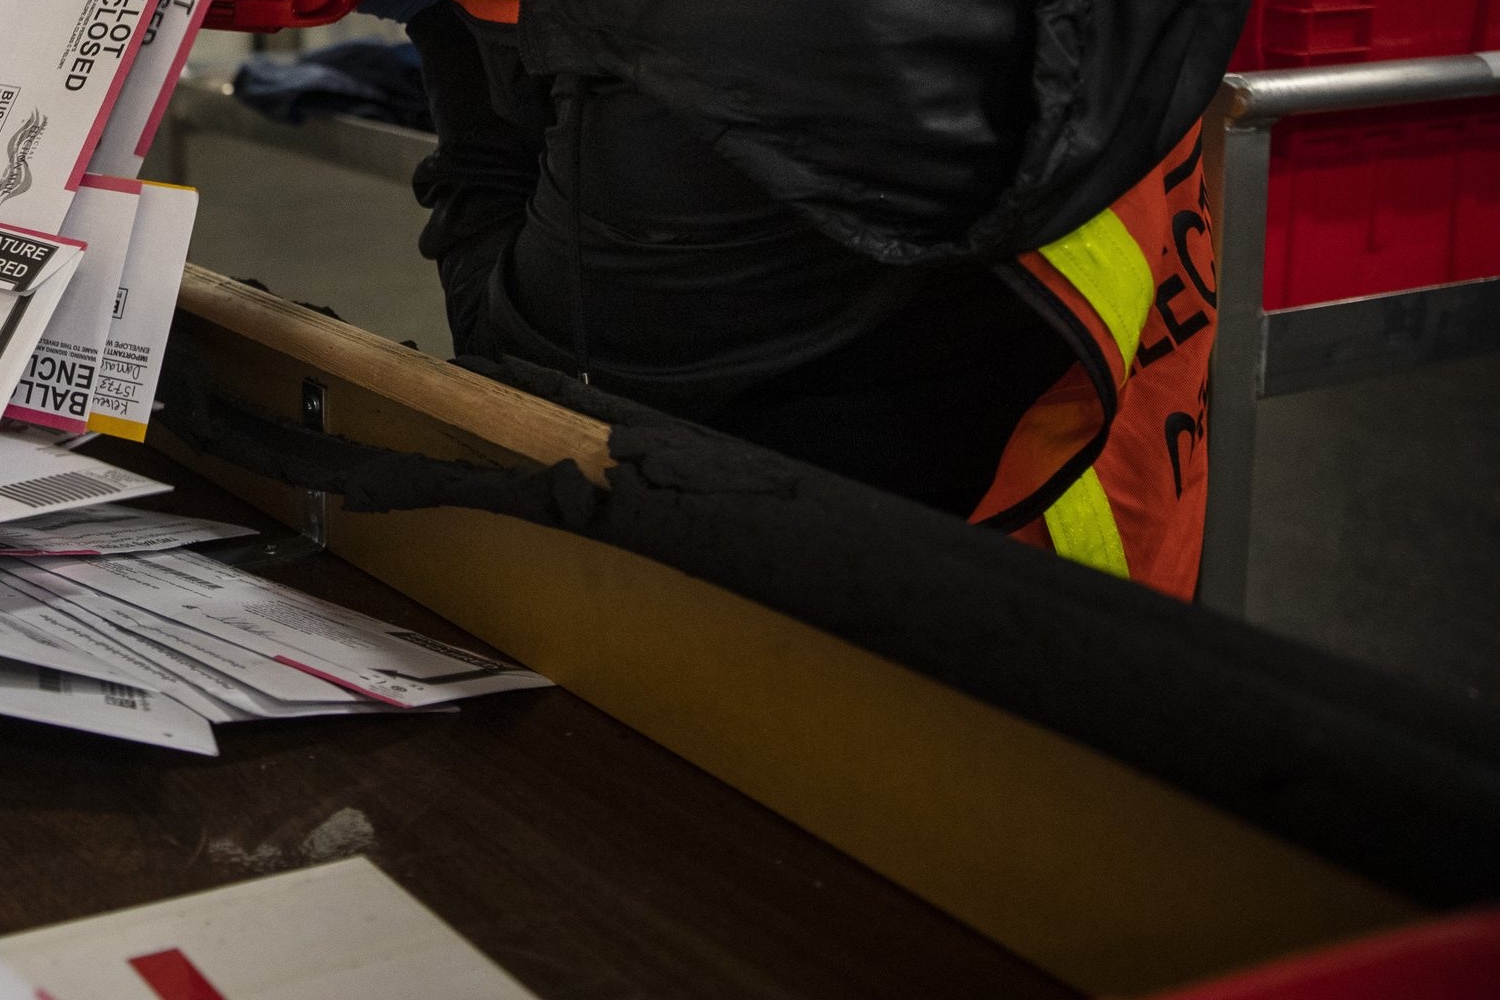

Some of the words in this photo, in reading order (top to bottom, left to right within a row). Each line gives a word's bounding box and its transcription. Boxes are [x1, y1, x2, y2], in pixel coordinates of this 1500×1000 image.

[48, 348, 68, 358] SIGNING
[82, 346, 98, 354] NAME
[114, 341, 150, 354] ENVELOPE
[69, 352, 97, 363] WARNING:
[100, 378, 135, 397] 15773
[11, 380, 89, 417] BALL
